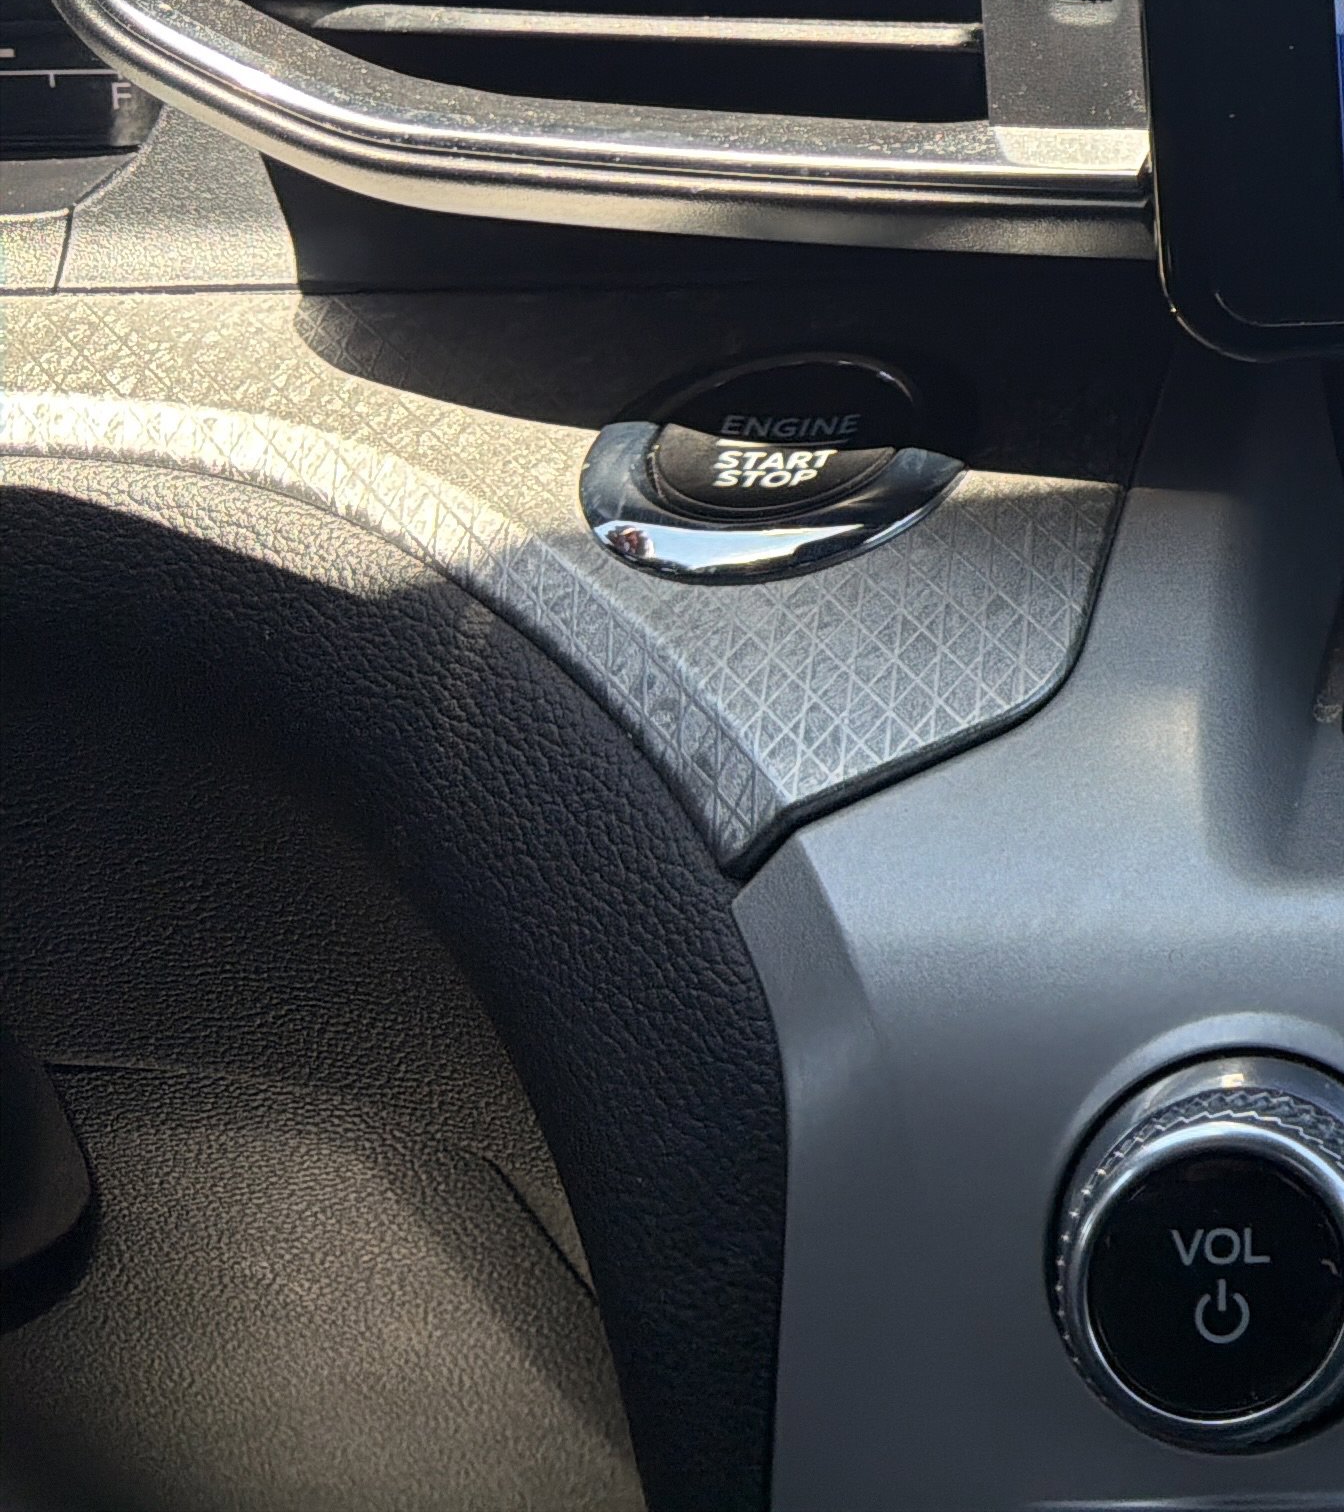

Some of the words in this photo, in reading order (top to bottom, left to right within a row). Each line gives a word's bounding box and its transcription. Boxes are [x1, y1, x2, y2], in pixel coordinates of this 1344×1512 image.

[111, 82, 132, 110] F
[719, 413, 861, 439] ENGINE
[713, 449, 838, 471] START
[712, 468, 818, 489] STOP
[1170, 1226, 1271, 1266] VOL
